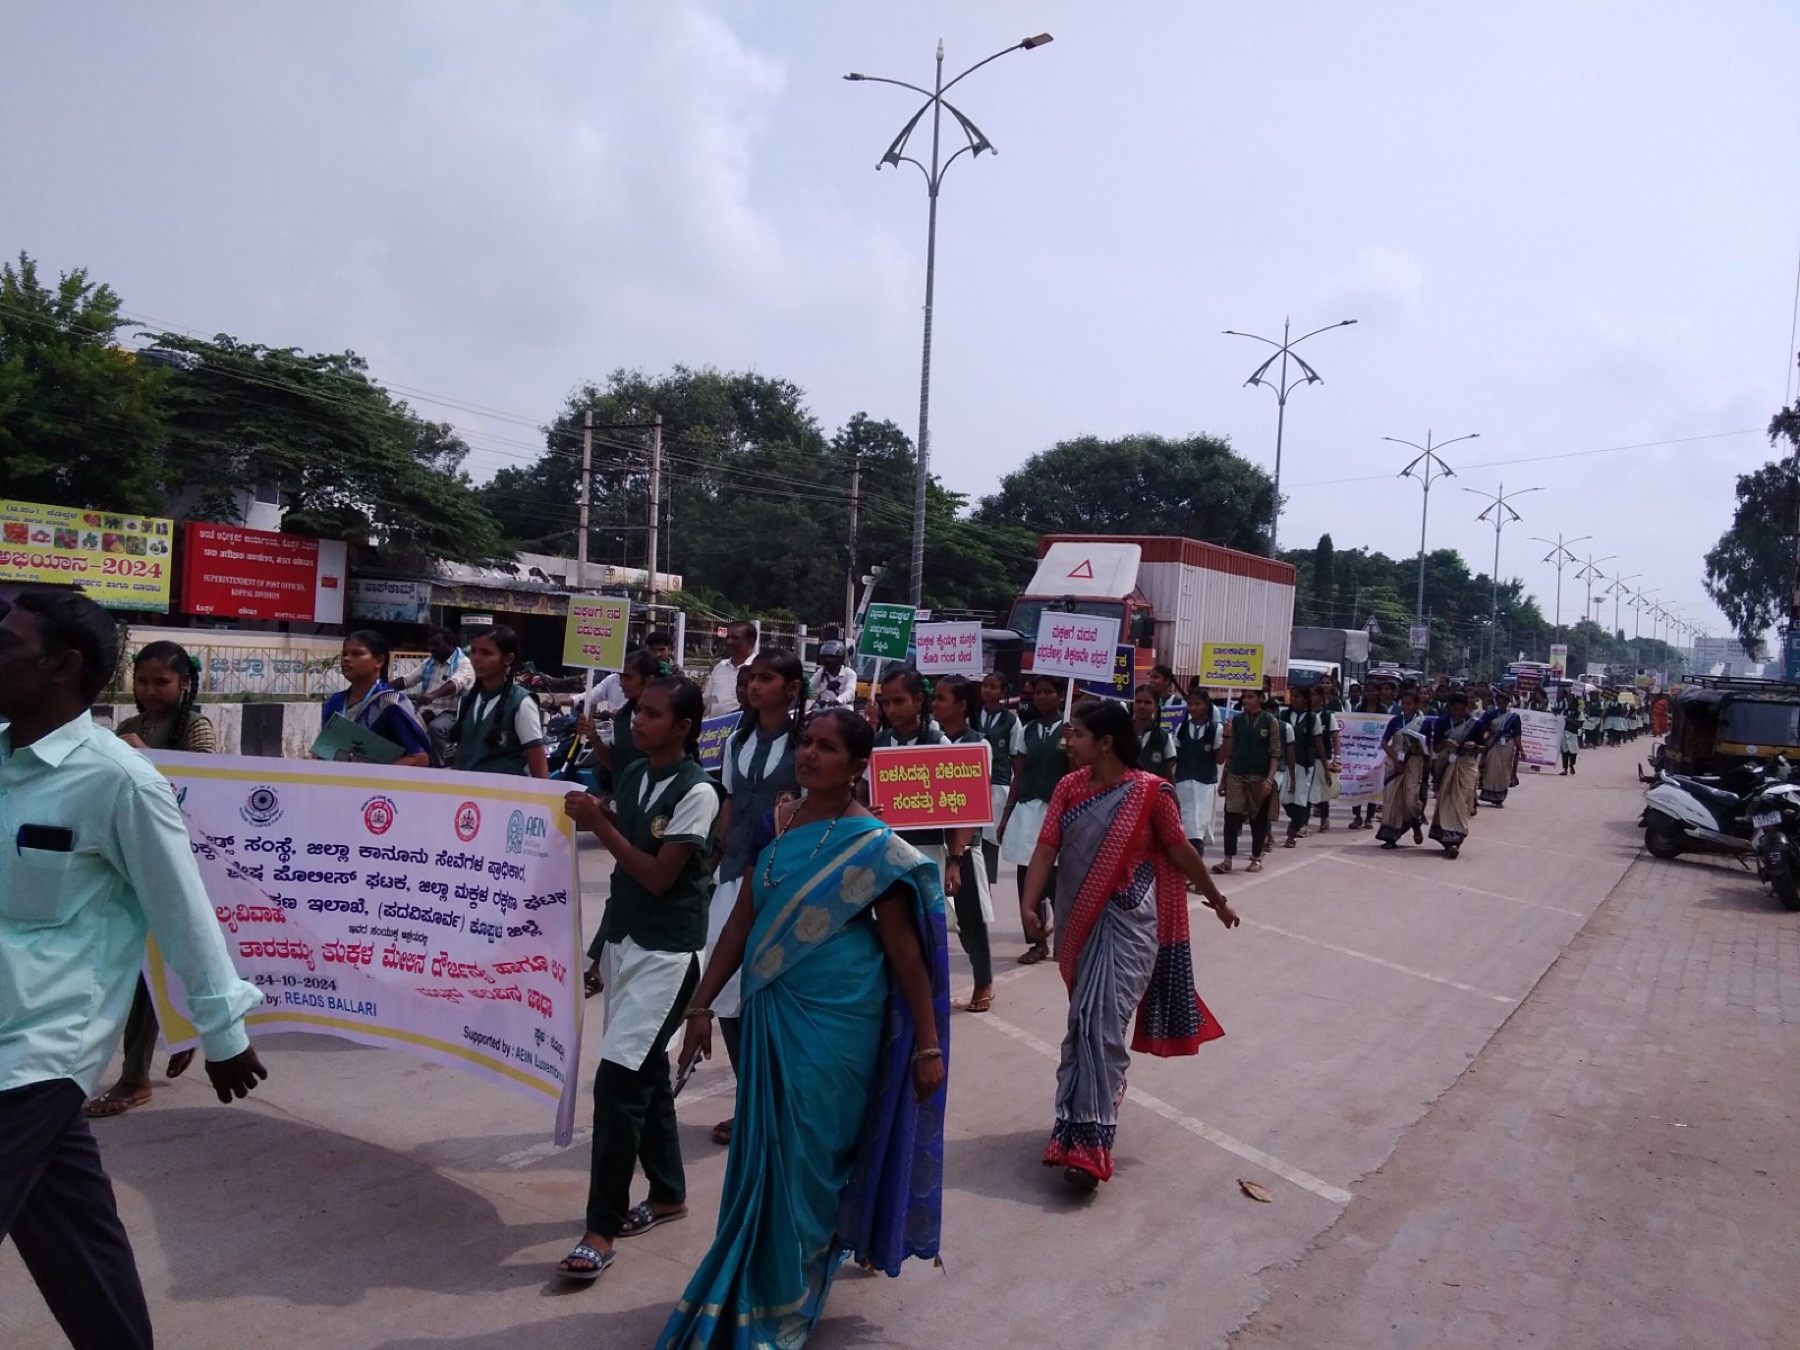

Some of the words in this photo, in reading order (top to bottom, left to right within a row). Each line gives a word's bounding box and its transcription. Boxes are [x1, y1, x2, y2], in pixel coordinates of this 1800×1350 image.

[203, 574, 256, 586] SUPERINTENDENT
[256, 578, 264, 586] OF
[266, 580, 280, 588] POST
[231, 588, 254, 598] KOPPAL
[254, 590, 280, 600] DIVISION
[210, 658, 264, 679] ಜಿಲ್ಲಾ
[879, 764, 930, 789] ಬಳಸಿದಷ್ಟು
[935, 762, 982, 780] ಬೆಳೆಯುವ
[892, 792, 934, 814] ಸಂಪತ್ತು
[938, 790, 966, 815] ಶಿಕ್ಷಣ
[244, 836, 296, 863] ಸಂಸ್ಥೆ,
[306, 842, 350, 862] ಜಿಲ್ಲಾ
[359, 846, 428, 864] ಕಾನೂನು
[434, 850, 484, 872] ಸೇವೆಗಳ
[488, 860, 526, 882] ಪ್ರಾಧಿಕಾರ,
[273, 865, 357, 884] ಪೊಲೀಸ್
[366, 872, 411, 892] ಘಟಕ,
[418, 880, 448, 901] ಜಿಲ್ಲಾ
[454, 882, 489, 910] ಮಕ್ಕಳ
[493, 890, 518, 916] ರಕ್ಷಣಾ
[523, 888, 566, 910] ಘಟಕ
[216, 904, 286, 933] ಲ್ಯವಿವಾಹ
[307, 898, 368, 916] ಇಲಾಖೆ,
[378, 900, 466, 934] (ಪದವಿಪೂರ್ವ)
[470, 918, 502, 944] ಕೊಪ್ಪಳ
[348, 924, 368, 934] ಇವರ
[370, 925, 398, 942] ಸಂಯುಕ್ತ
[238, 936, 316, 972] ತಾರತಮ್ಯ
[382, 942, 427, 974] ಮೇಲಿನ
[432, 951, 496, 984] ದೌರ್ಜನ್ಯ
[492, 954, 548, 976] ಹಾಗೂ
[255, 974, 337, 990] 24-10-2024
[266, 993, 282, 1006] by:
[285, 992, 325, 1008] READS
[328, 996, 377, 1016] BALLARI
[463, 1026, 501, 1051] Supported
